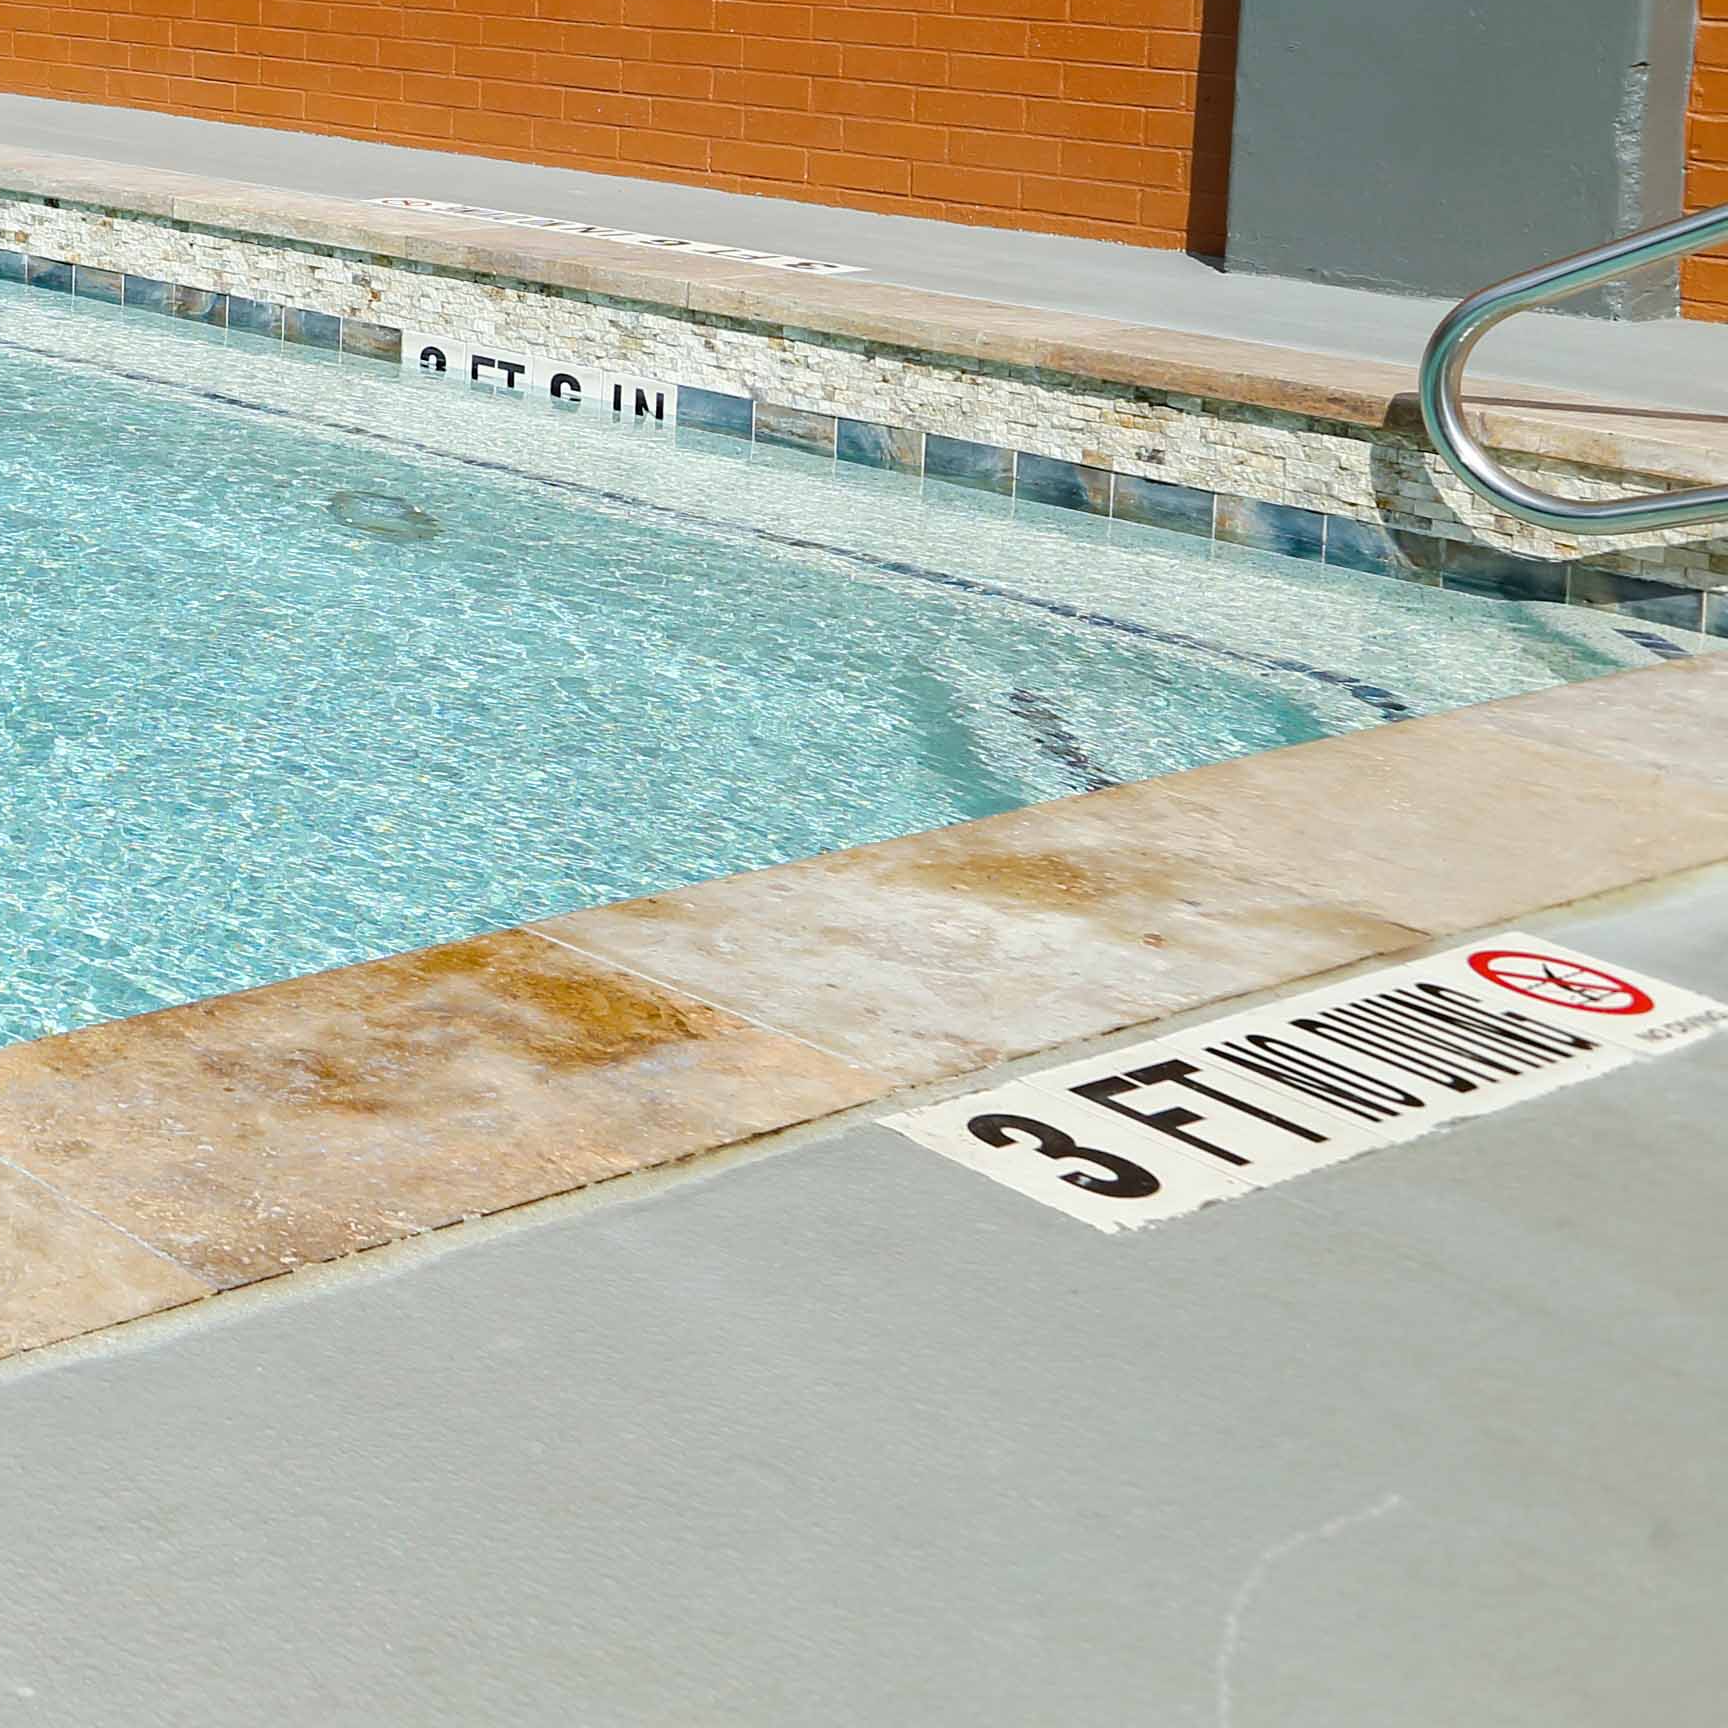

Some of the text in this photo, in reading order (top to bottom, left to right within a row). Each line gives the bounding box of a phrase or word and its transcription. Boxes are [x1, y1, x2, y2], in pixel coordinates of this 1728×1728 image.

[967, 983, 1599, 1198] 3 FT NO DIVING
